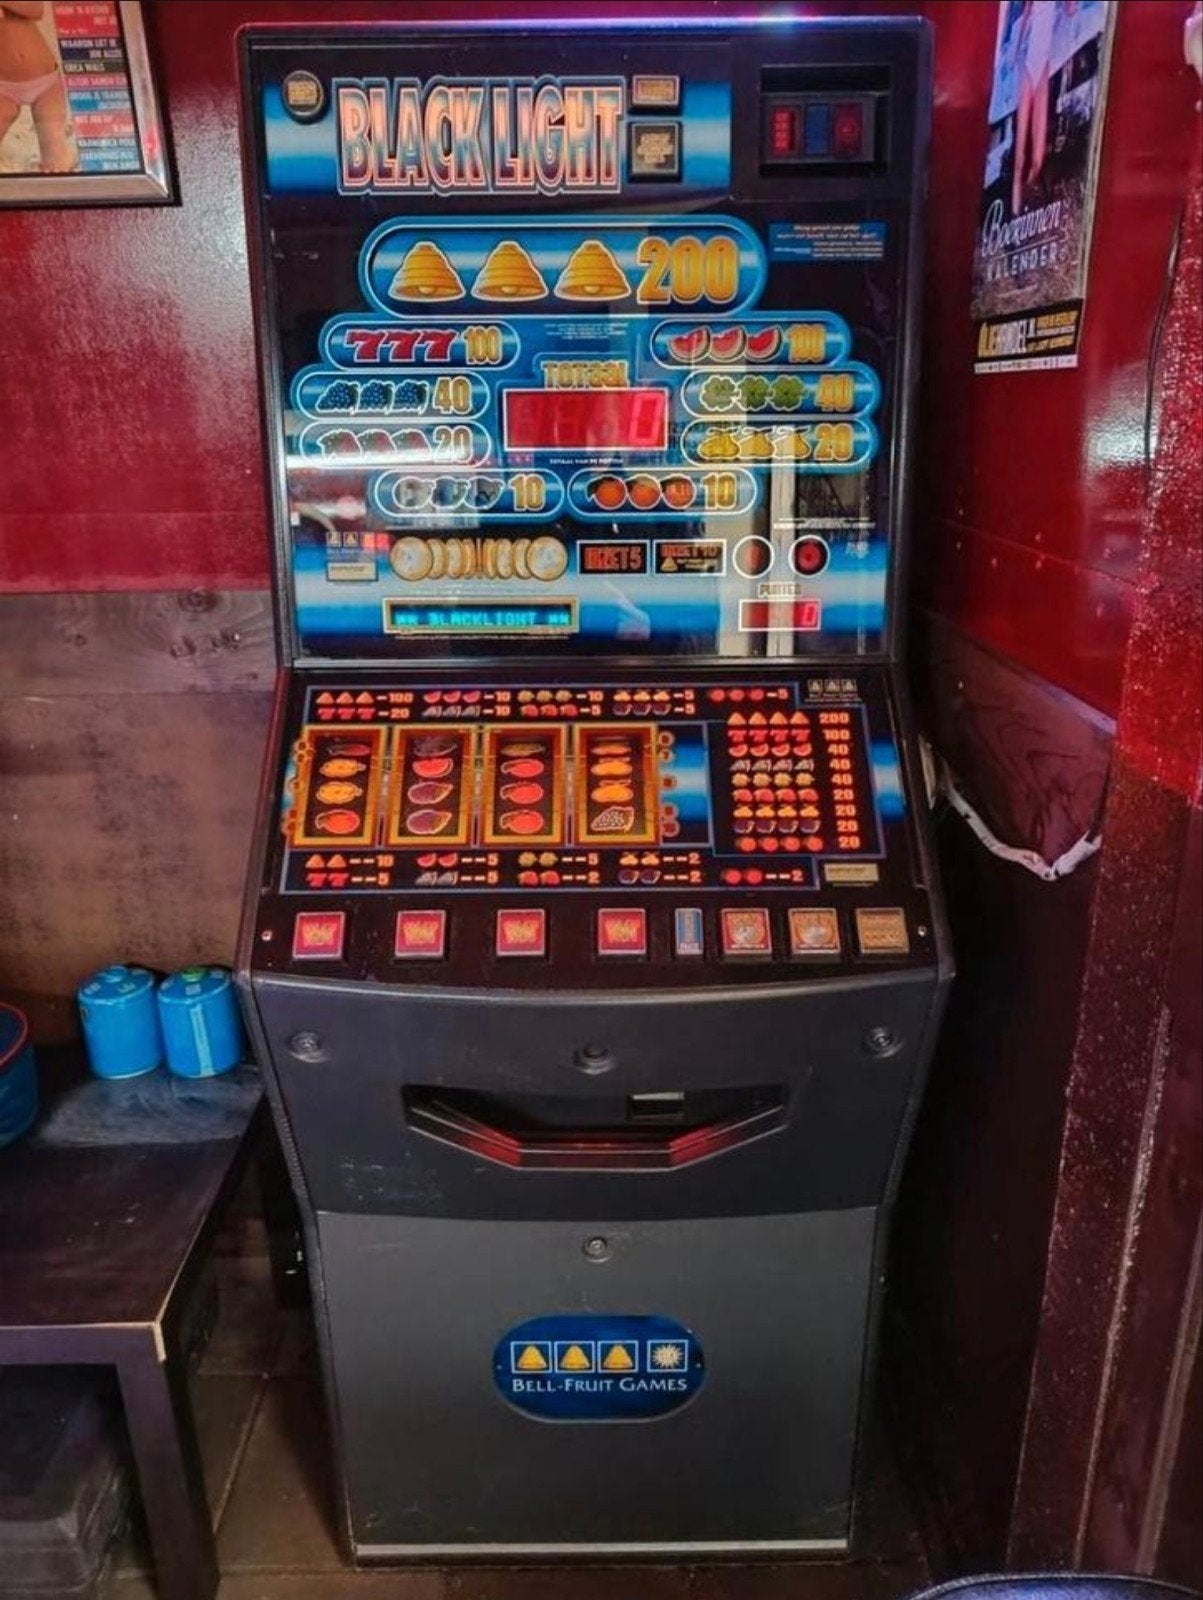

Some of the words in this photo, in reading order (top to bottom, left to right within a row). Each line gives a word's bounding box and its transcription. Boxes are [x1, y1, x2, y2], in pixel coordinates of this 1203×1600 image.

[334, 78, 487, 193] BLACK
[492, 78, 625, 193] LIGHT
[637, 236, 739, 304] 200
[462, 326, 502, 365] 100
[433, 376, 472, 414] 40
[814, 373, 854, 412] 40
[433, 426, 473, 463] 20
[813, 422, 854, 461] 20
[508, 474, 546, 511] 10
[703, 472, 737, 510] 10
[629, 546, 642, 570] 5
[389, 692, 414, 704] 100
[495, 691, 511, 702] 10
[588, 690, 603, 702] 10
[390, 707, 411, 719] 20
[494, 706, 511, 717] 10
[819, 712, 850, 724] 200
[823, 729, 850, 740] 100
[828, 744, 849, 755] 40
[830, 759, 851, 770] 40
[831, 773, 853, 785] 40
[834, 789, 854, 800] 20
[835, 804, 856, 816] 20
[837, 820, 858, 832] 20
[839, 836, 860, 849] 20
[487, 853, 499, 866] 5
[588, 853, 599, 865] 5
[689, 853, 701, 864] 2
[378, 872, 390, 885] 5
[588, 872, 600, 884] 2
[690, 871, 702, 883] 2
[792, 870, 803, 882] 2
[512, 1378, 614, 1392] BELL-FRUIT
[619, 1377, 688, 1392] GAMES
